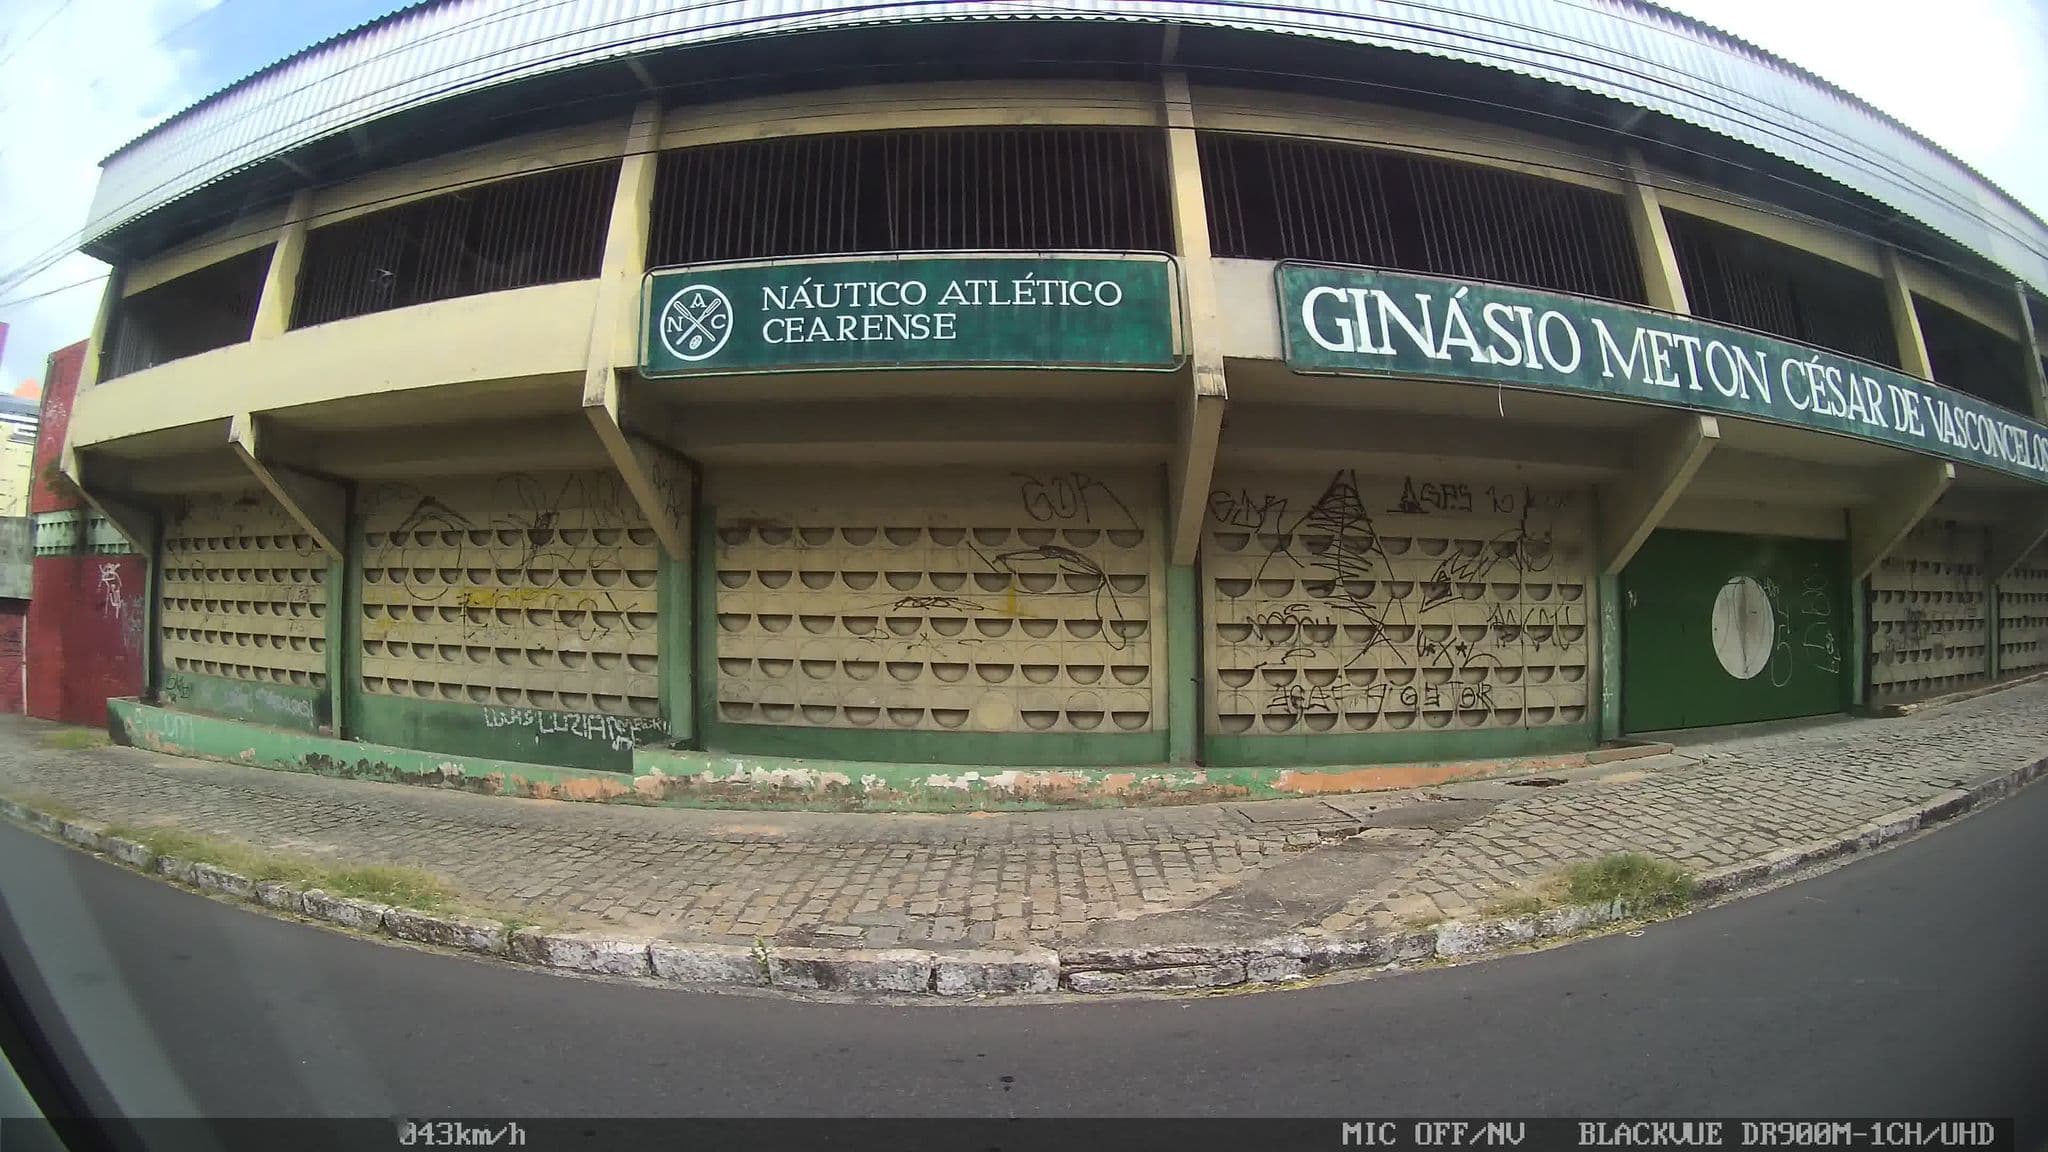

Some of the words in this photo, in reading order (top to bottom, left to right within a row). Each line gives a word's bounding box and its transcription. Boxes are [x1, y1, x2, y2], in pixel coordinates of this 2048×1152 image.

[761, 276, 927, 311] NÁUTICO
[937, 271, 1123, 307] ATLÉTICO
[762, 313, 958, 345] CEARENSE
[1301, 285, 1583, 375] GINÁSIO
[1591, 317, 1772, 405] METON
[1780, 354, 1889, 428] CÉSAR
[1887, 384, 1926, 437] DE
